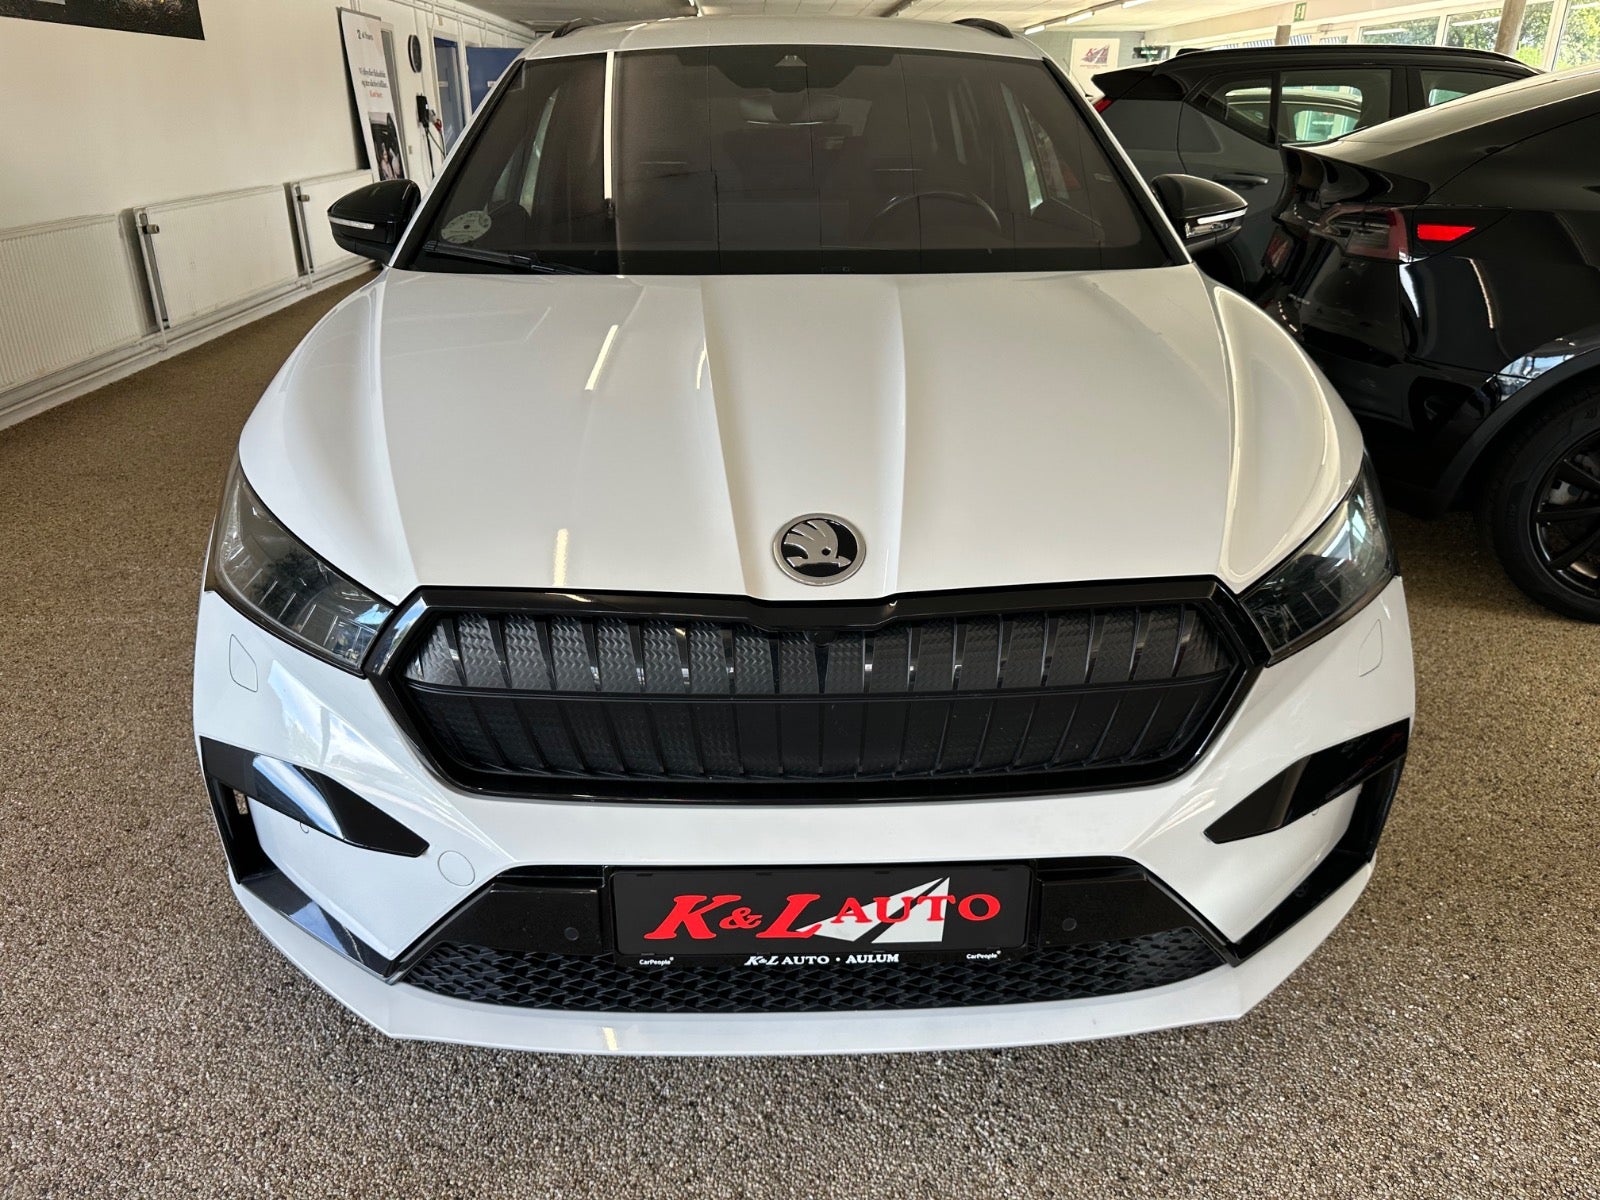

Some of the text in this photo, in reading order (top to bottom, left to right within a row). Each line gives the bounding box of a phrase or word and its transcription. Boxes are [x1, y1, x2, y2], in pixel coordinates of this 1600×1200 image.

[643, 893, 1001, 940] K&L AUTO
[744, 953, 900, 966] K&L AUTO AULUM
[966, 951, 1001, 960] CarPeople
[638, 957, 674, 967] CarPeople
